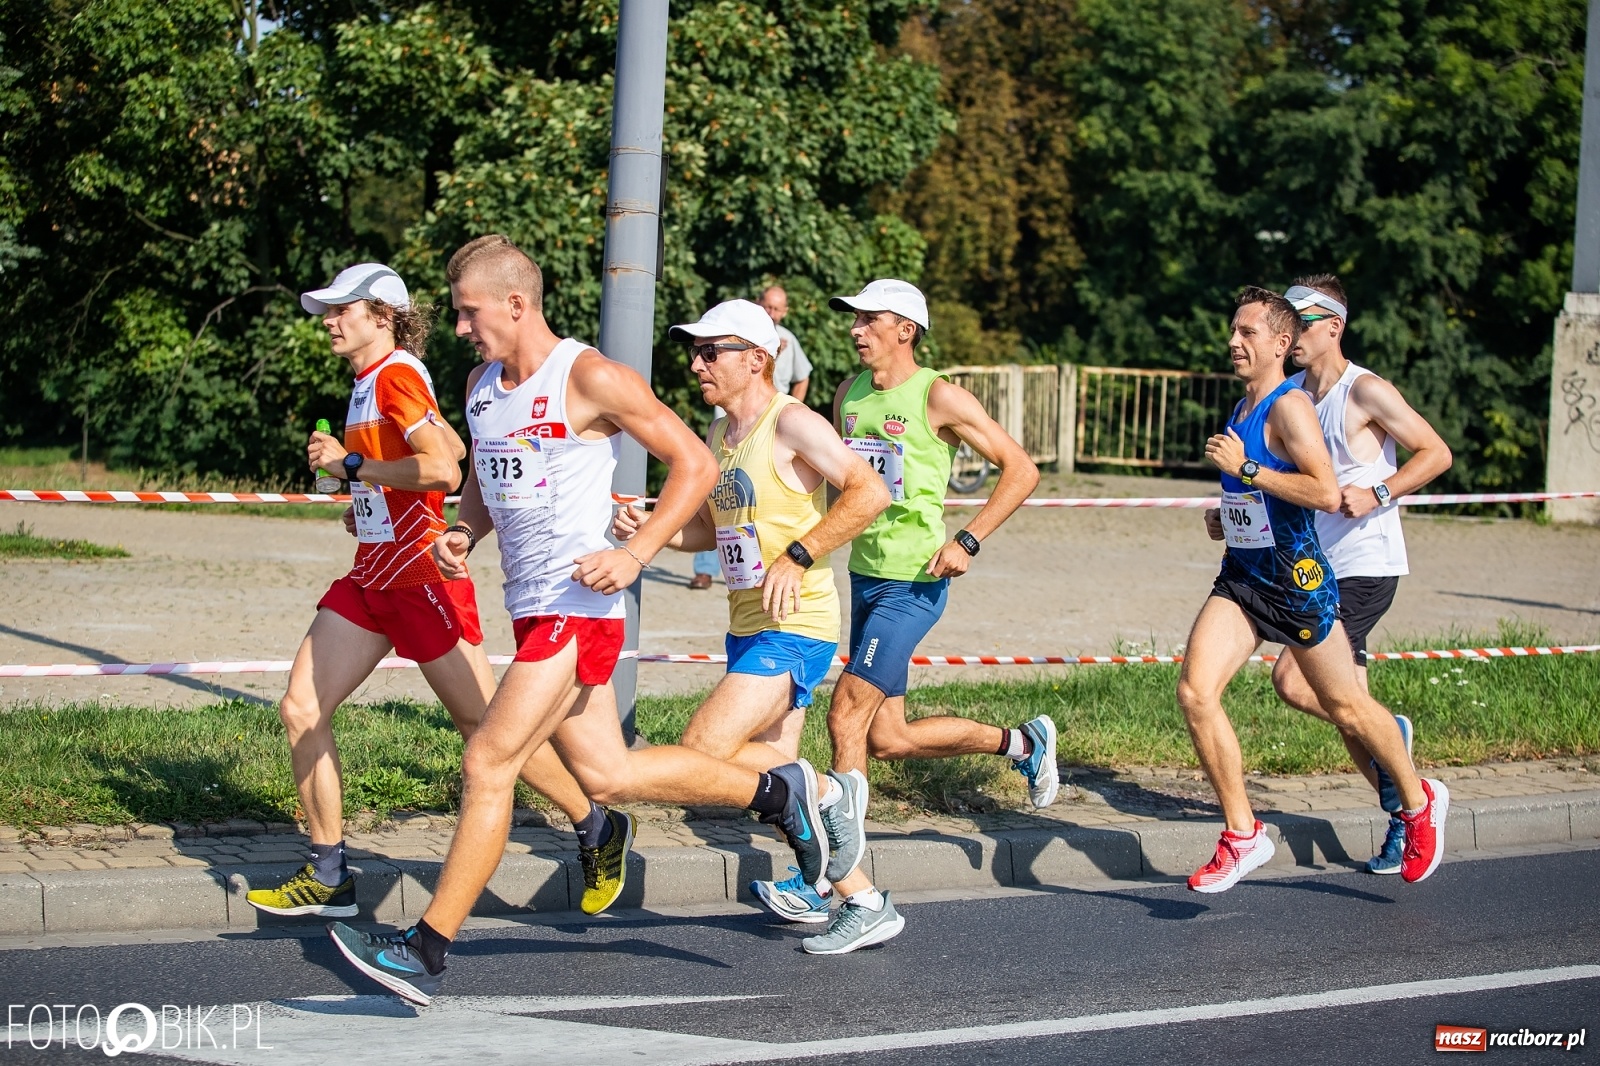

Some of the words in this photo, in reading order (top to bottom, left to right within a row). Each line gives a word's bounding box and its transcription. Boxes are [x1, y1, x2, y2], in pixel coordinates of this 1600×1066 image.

[470, 400, 492, 416] 4F
[885, 413, 909, 424] EASY
[886, 423, 903, 432] RUN
[489, 456, 524, 480] 373
[719, 468, 735, 484] THE
[354, 497, 373, 518] 285
[714, 495, 737, 513] FACE
[1228, 507, 1252, 527] 406
[721, 543, 745, 565] 132
[1296, 562, 1323, 588] Buff
[423, 584, 453, 630] POLSKA
[548, 614, 568, 643] POL
[863, 637, 880, 668] Joma
